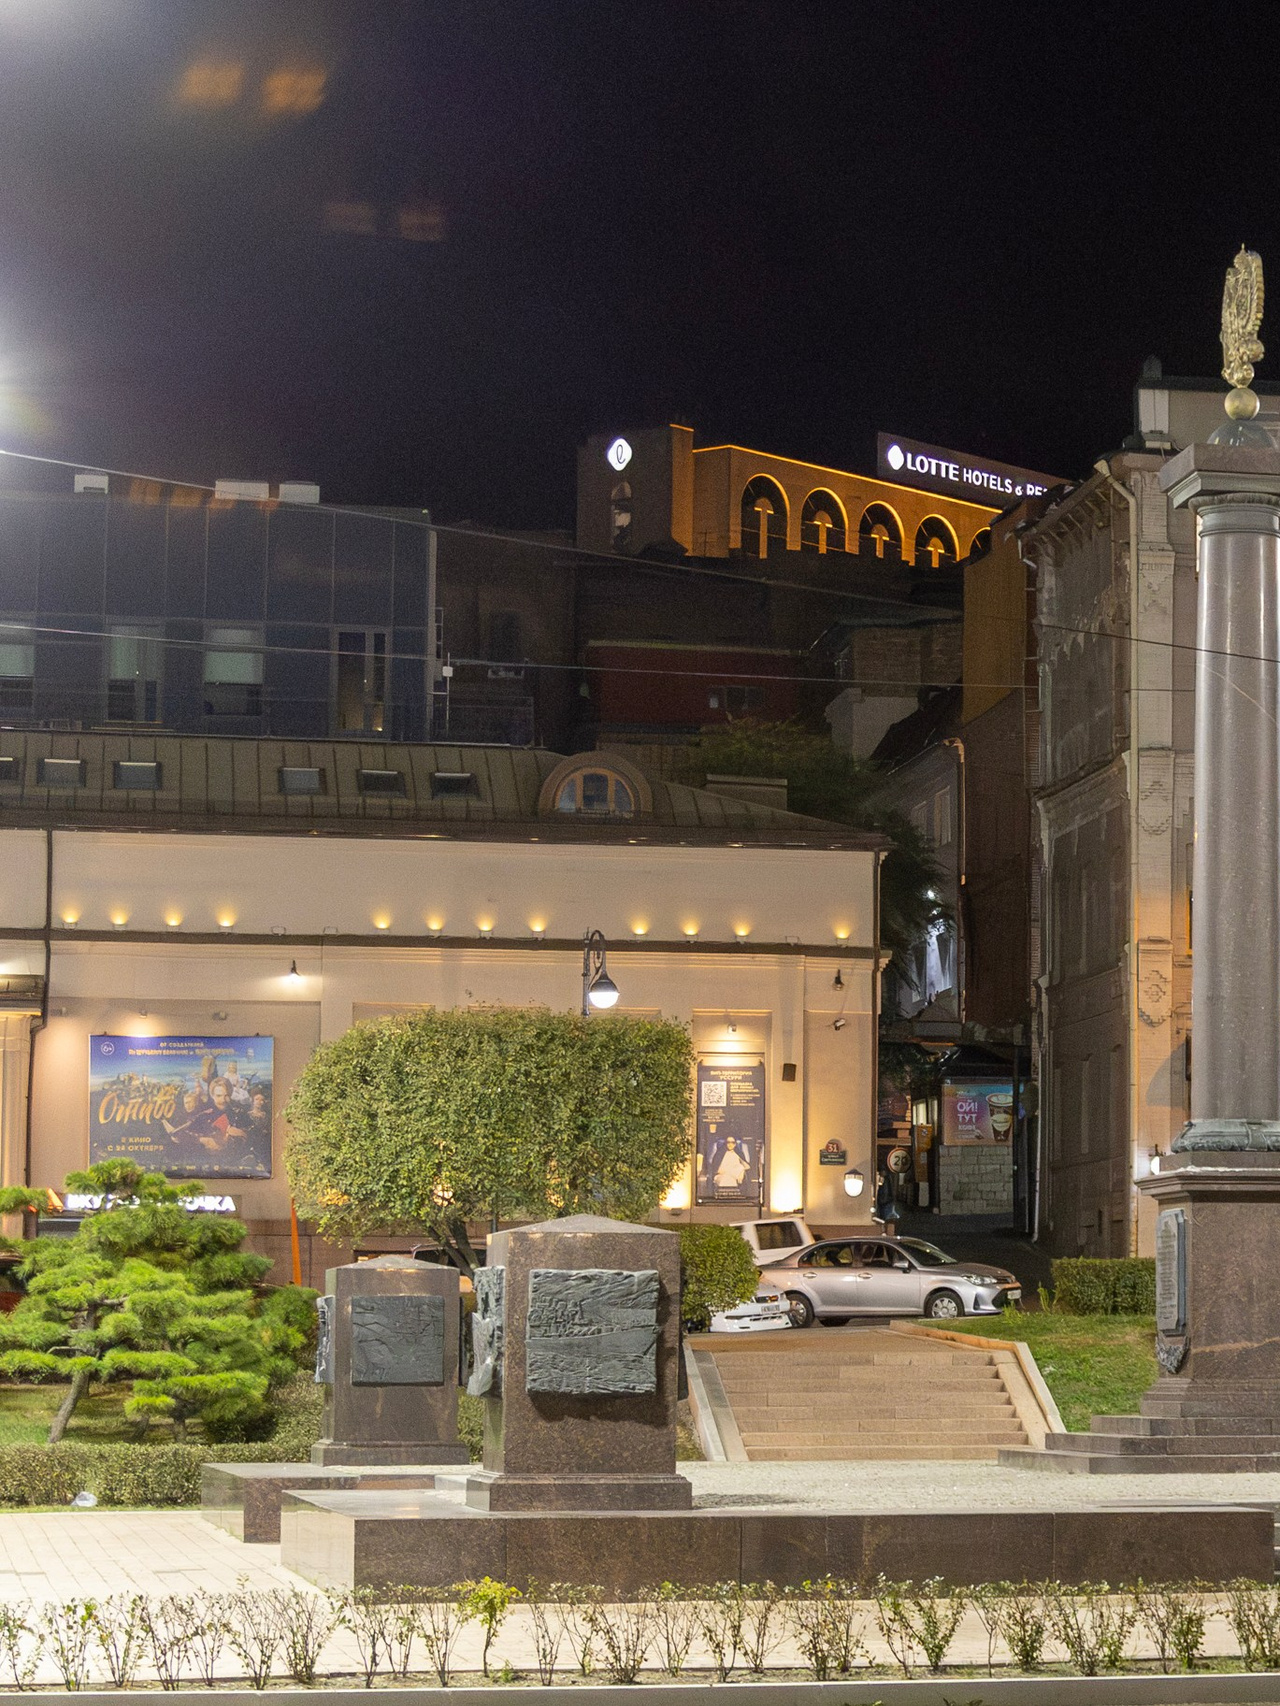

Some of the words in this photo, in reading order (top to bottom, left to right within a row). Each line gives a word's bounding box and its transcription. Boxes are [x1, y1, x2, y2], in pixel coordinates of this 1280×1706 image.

[906, 452, 959, 481] LOTTE
[963, 467, 1013, 494] HOTELS
[1026, 483, 1048, 496] RE
[957, 1099, 978, 1112] ОЙ!
[957, 1113, 977, 1123] ТУТ
[827, 1143, 839, 1152] 31
